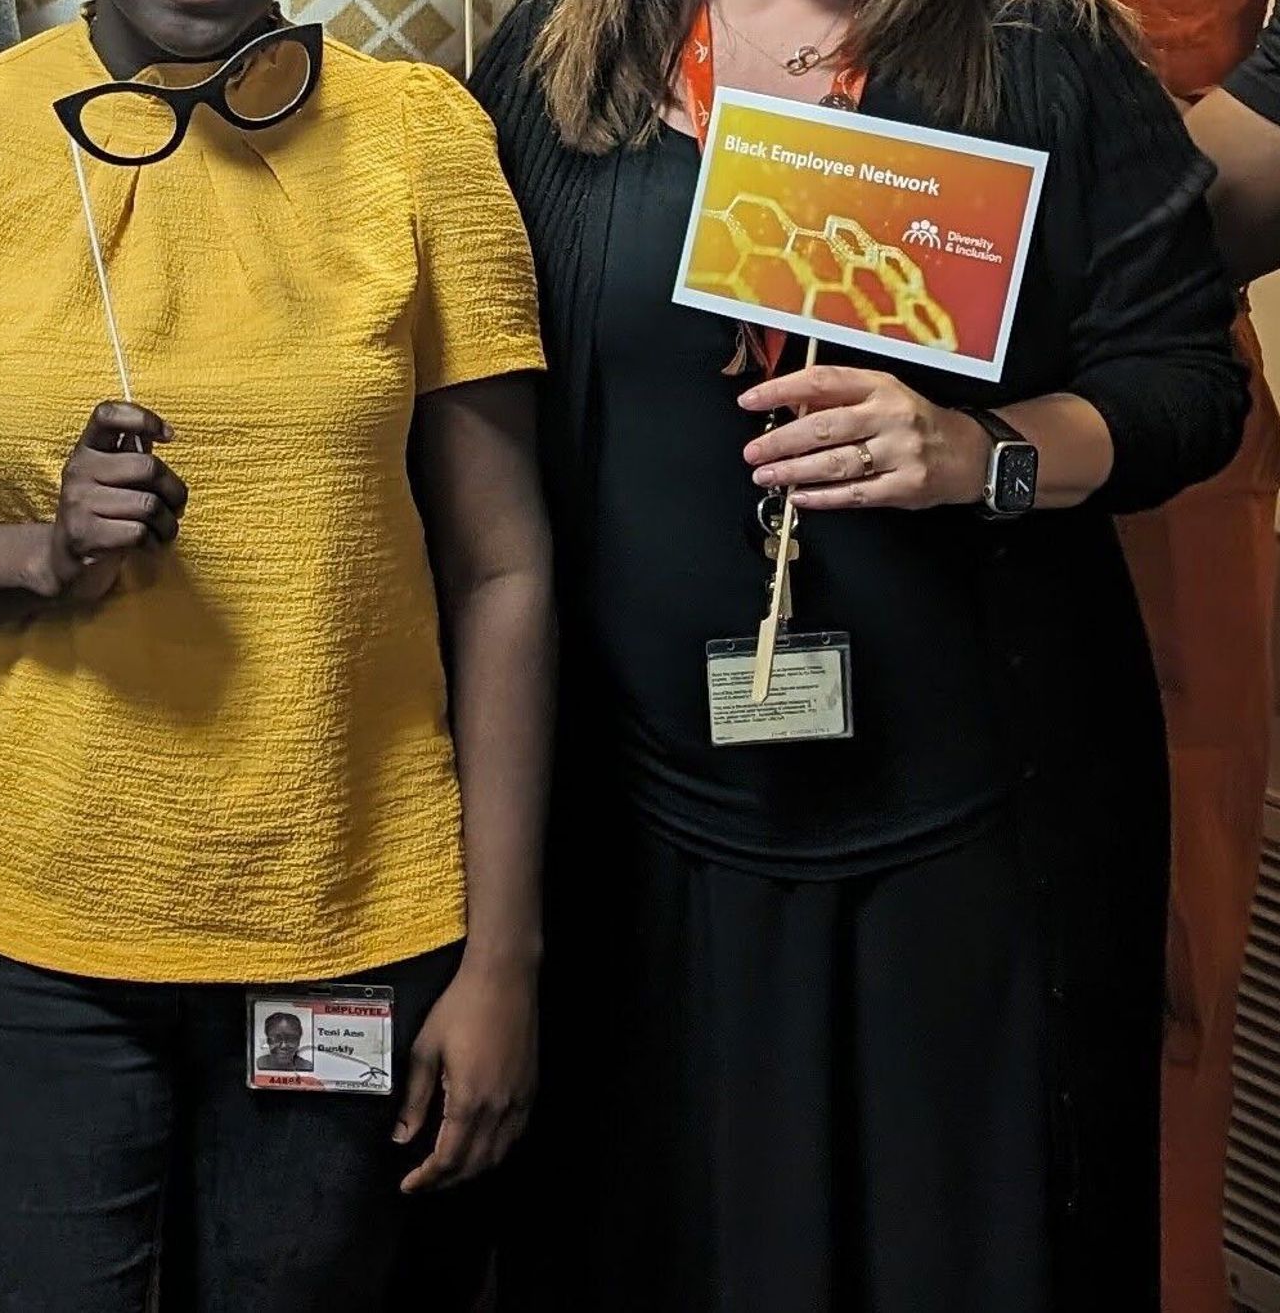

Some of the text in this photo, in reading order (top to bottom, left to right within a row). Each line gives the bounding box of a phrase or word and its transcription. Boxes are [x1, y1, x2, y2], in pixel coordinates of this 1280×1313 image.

[724, 134, 941, 197] Black Employee Network
[947, 230, 994, 250] Diversity
[945, 242, 1002, 264] & Inclusion
